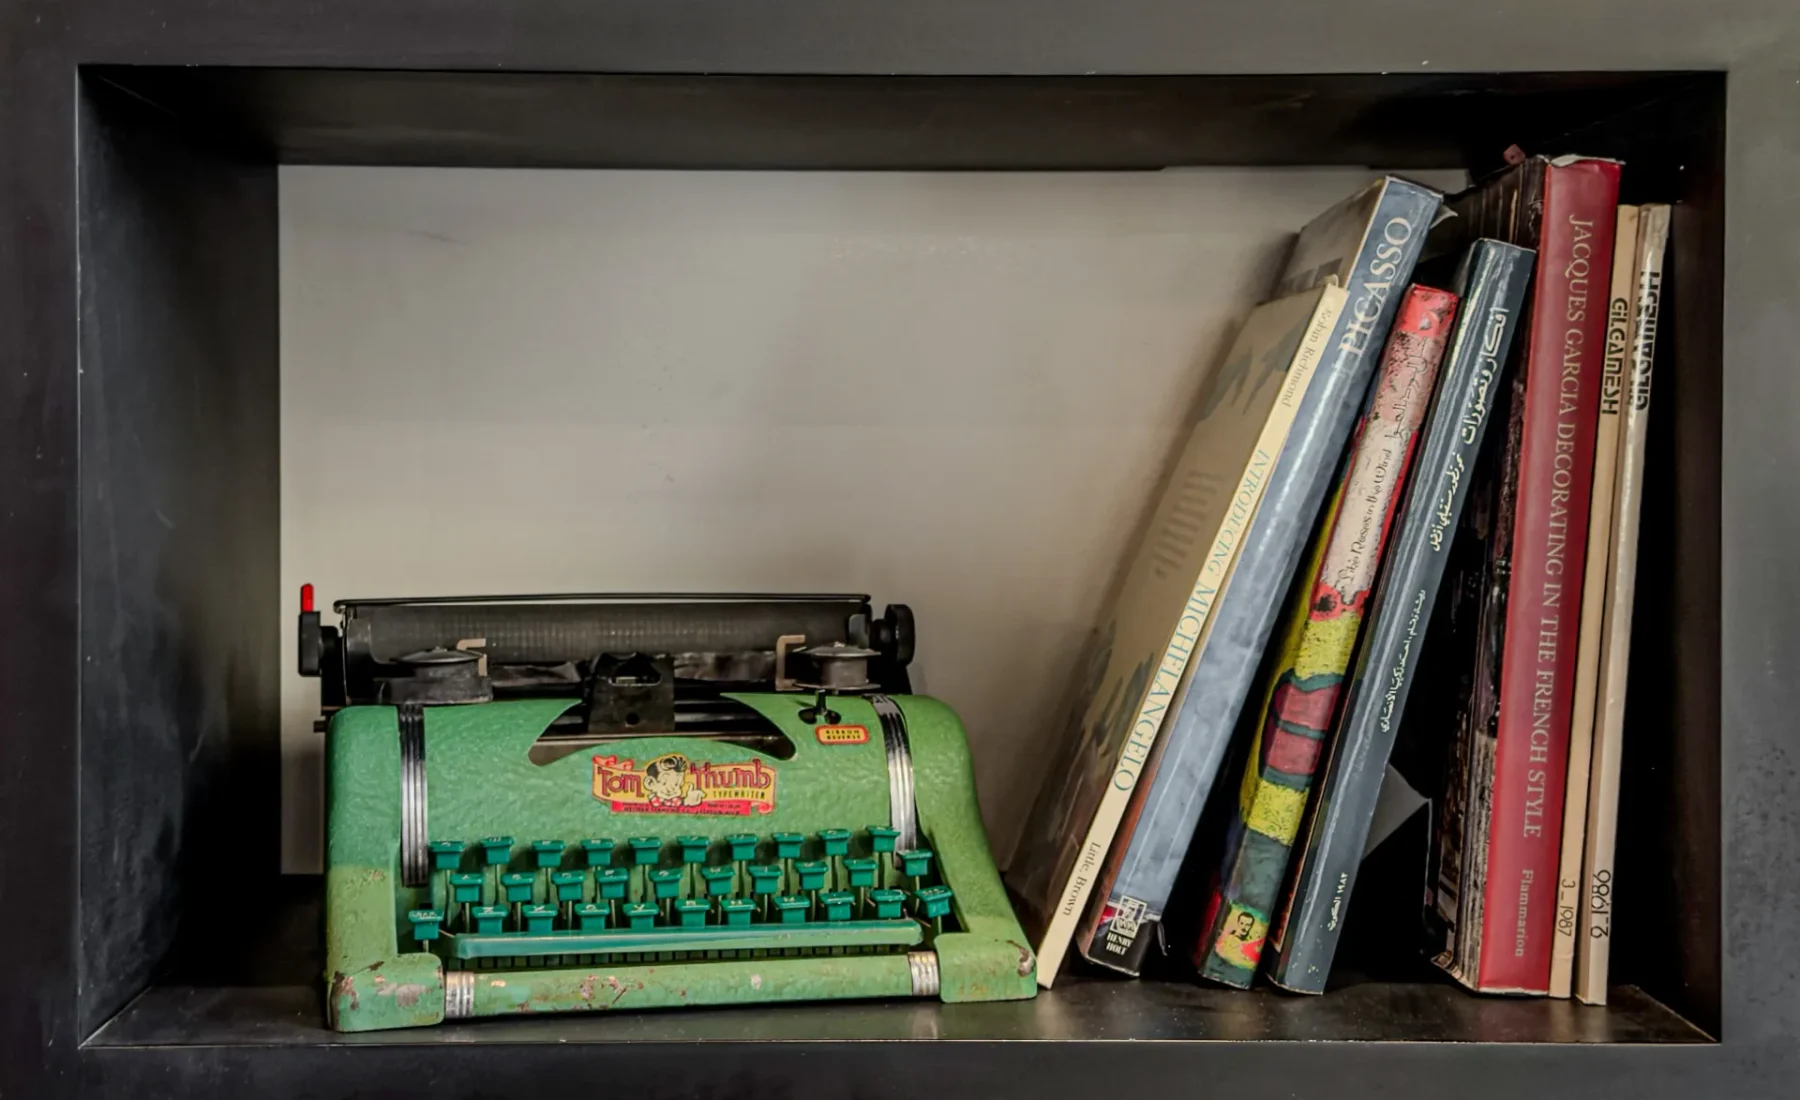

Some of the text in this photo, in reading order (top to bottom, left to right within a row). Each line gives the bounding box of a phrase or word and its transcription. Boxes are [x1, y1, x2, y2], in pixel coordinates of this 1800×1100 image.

[1337, 216, 1413, 357] PICASSO
[1281, 346, 1316, 409] Richmond
[1373, 449, 1392, 485] Wind
[1366, 484, 1383, 505] the
[1351, 514, 1373, 555] Roses
[1523, 213, 1594, 838] JACQUES GARCIA DECORATING IN THE FRENCH STYLE
[1113, 448, 1271, 792] INTRODUCING MICHELANGELO
[597, 758, 772, 798] Tom Thumb
[712, 790, 766, 800] TYPEWRITER
[1062, 841, 1102, 916] Little, Brown
[1514, 868, 1534, 958] Flammarion
[1105, 942, 1128, 956] HOLT
[1106, 931, 1134, 948] HENRY
